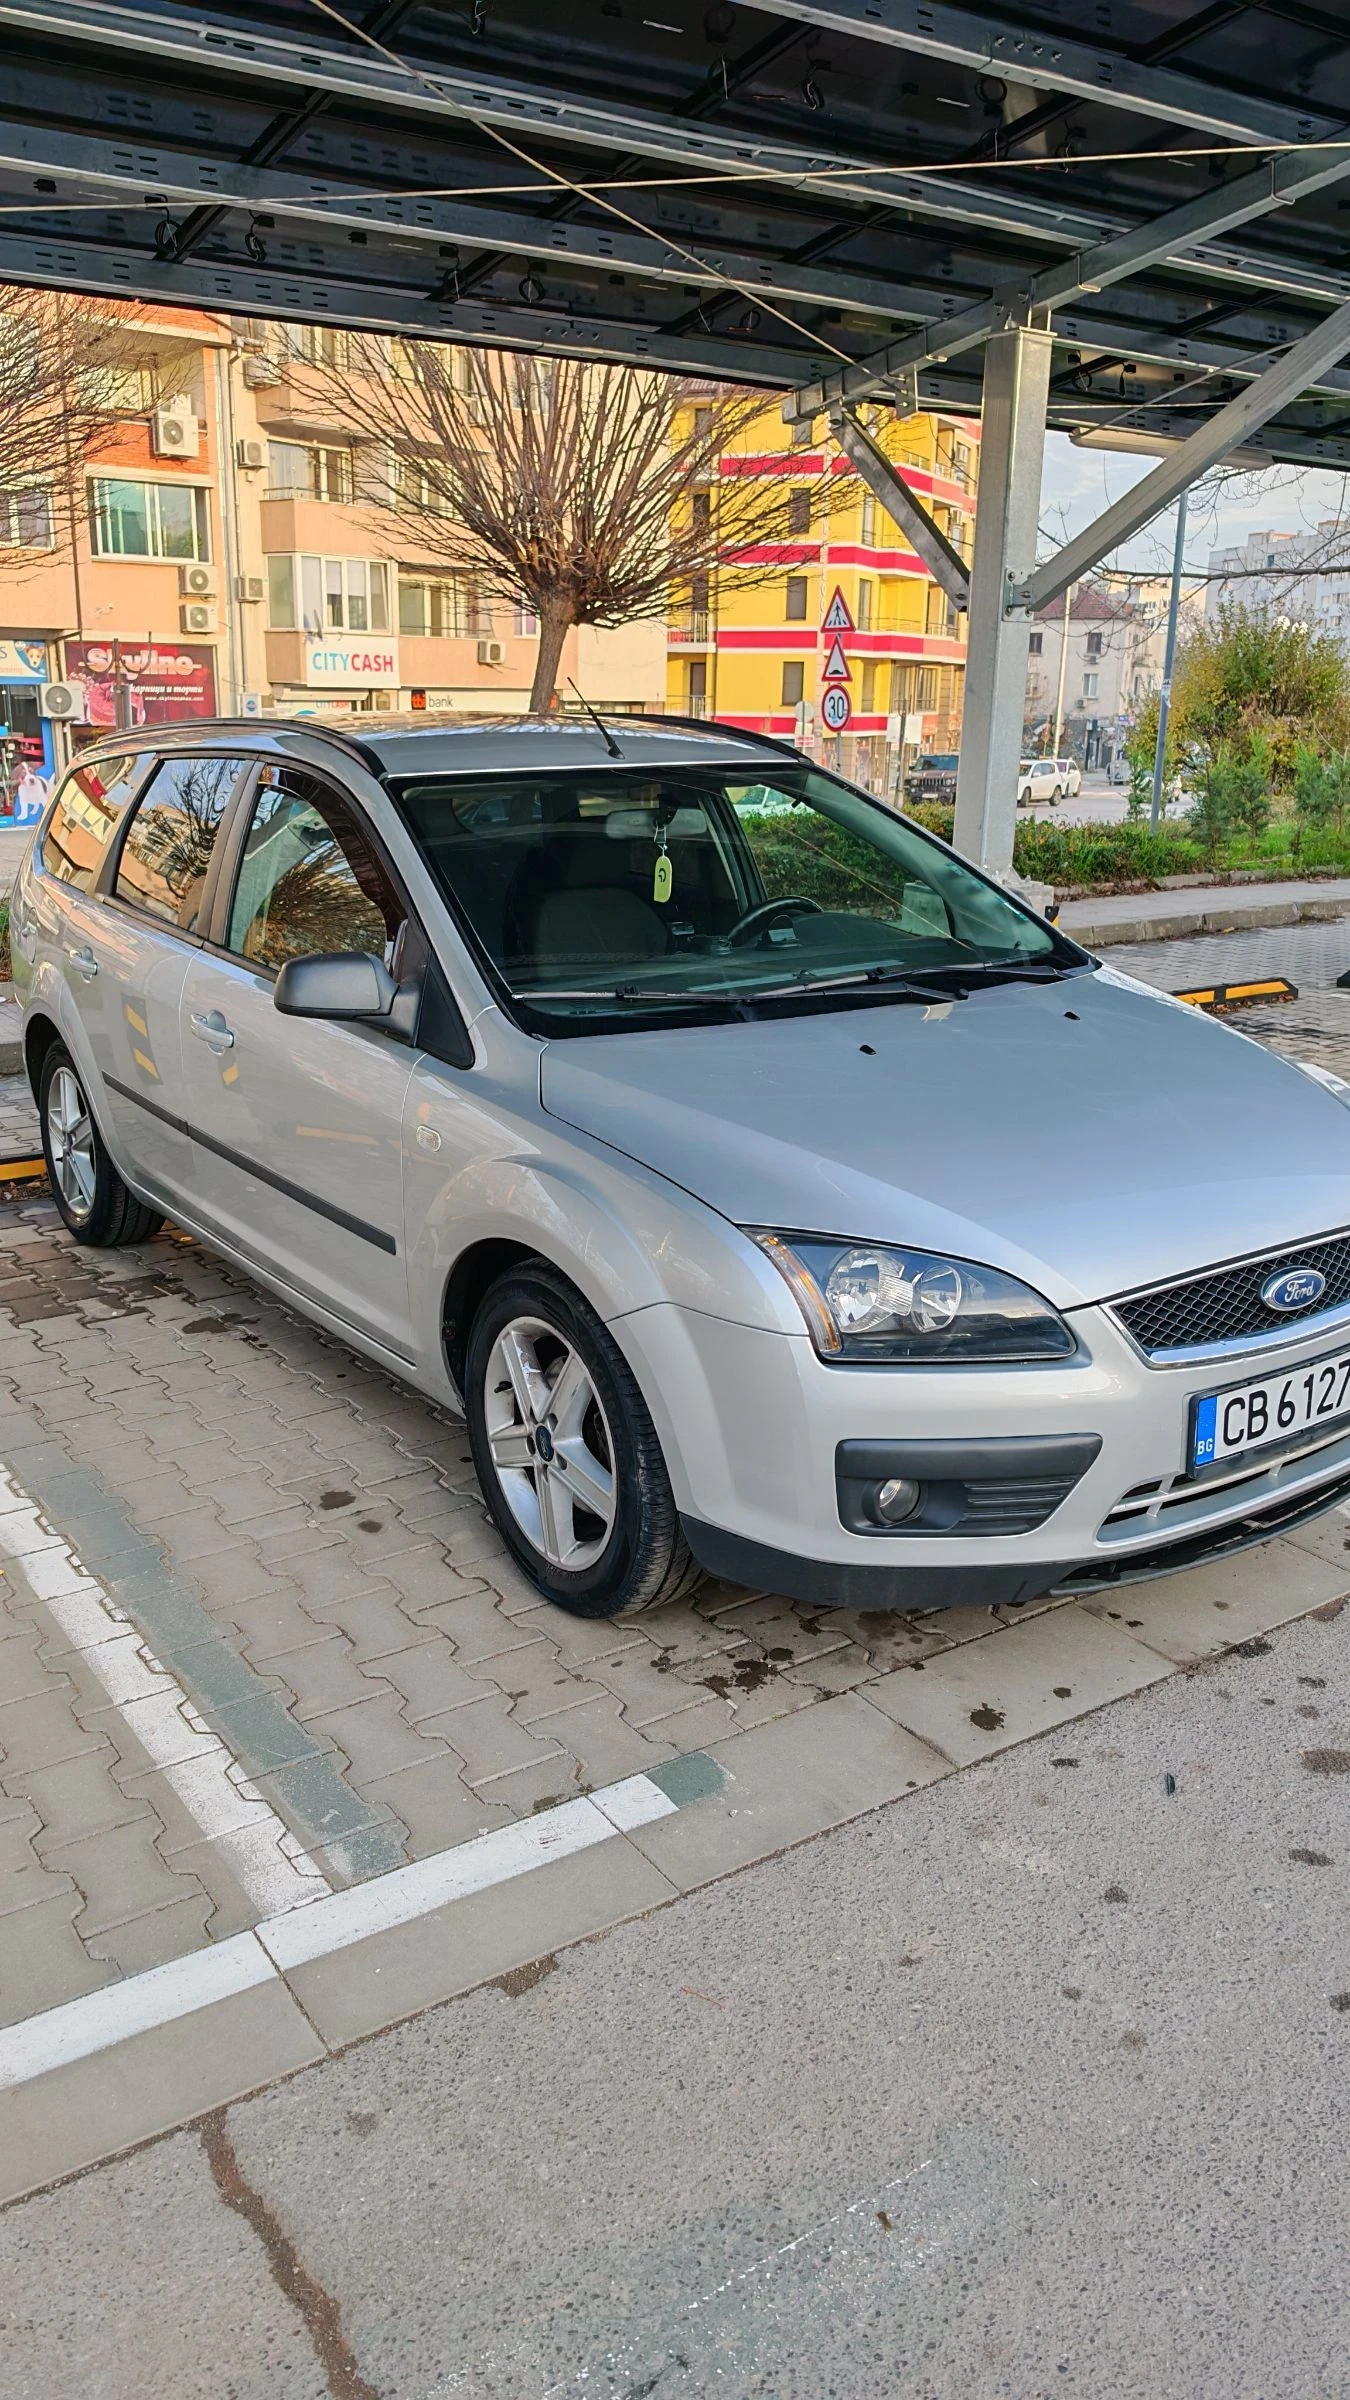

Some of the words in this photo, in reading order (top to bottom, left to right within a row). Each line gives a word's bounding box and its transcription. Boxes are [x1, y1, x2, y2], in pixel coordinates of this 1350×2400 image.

[79, 647, 202, 681] Skyline
[312, 652, 394, 672] CITYCASH
[173, 686, 203, 695] торти
[428, 695, 454, 708] bank
[828, 696, 845, 720] 30
[1284, 1278, 1315, 1302] Ford
[1197, 1438, 1213, 1455] BG
